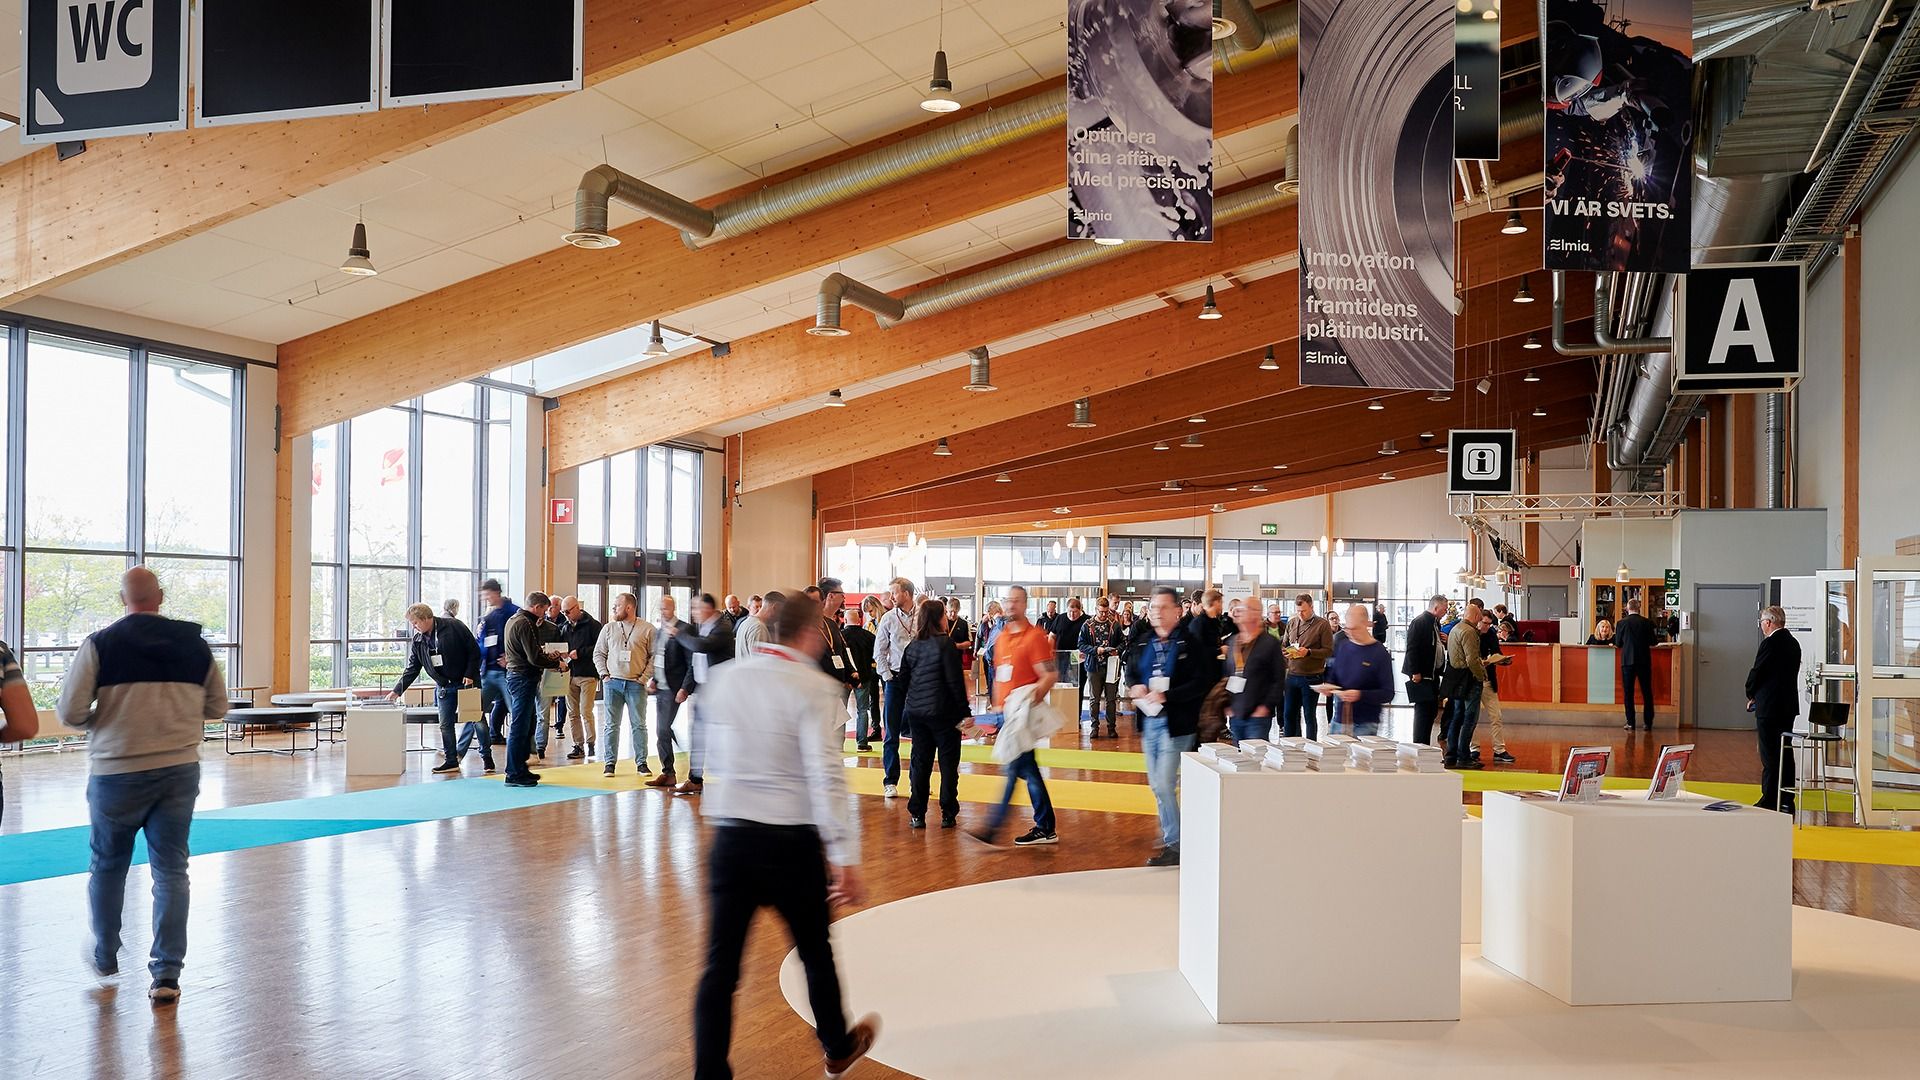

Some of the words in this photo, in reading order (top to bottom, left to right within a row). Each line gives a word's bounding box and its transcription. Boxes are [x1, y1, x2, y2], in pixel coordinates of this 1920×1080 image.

[69, 0, 143, 63] WC
[1073, 126, 1156, 145] Optimera
[1073, 148, 1111, 165] dina
[1116, 150, 1177, 167] affärer.
[1073, 171, 1113, 187] Med
[1118, 173, 1202, 190] precision.
[1551, 199, 1569, 216] VI
[1574, 197, 1602, 217] ÄR
[1606, 201, 1674, 220] SVETS.
[1306, 247, 1415, 270] Innovation
[1305, 271, 1377, 292] formar
[1305, 295, 1418, 318] framtidens
[1306, 318, 1430, 342] plåtindustri.
[1708, 278, 1775, 364] A
